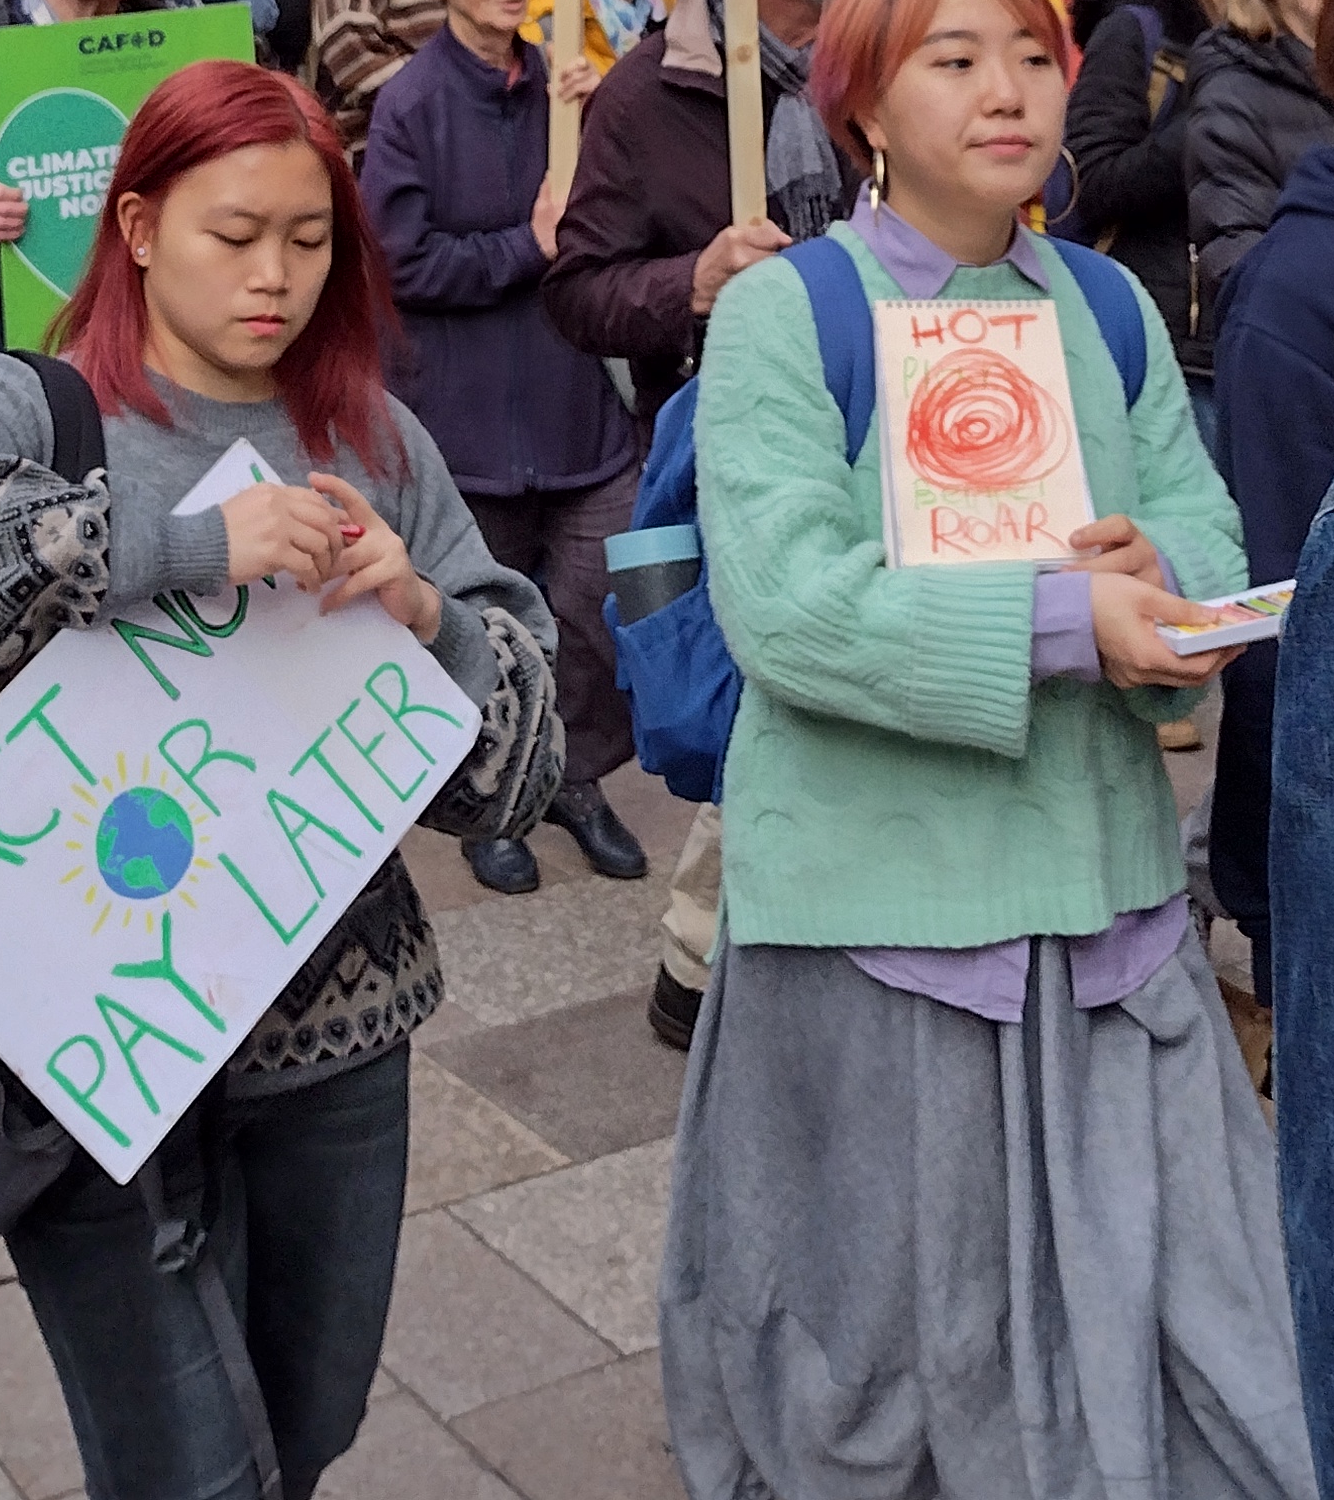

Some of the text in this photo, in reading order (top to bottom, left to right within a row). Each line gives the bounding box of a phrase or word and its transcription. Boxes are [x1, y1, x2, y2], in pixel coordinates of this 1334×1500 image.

[911, 308, 1038, 350] HOT
[930, 501, 1071, 555] ROAR
[46, 661, 464, 1148] PAY LATER
